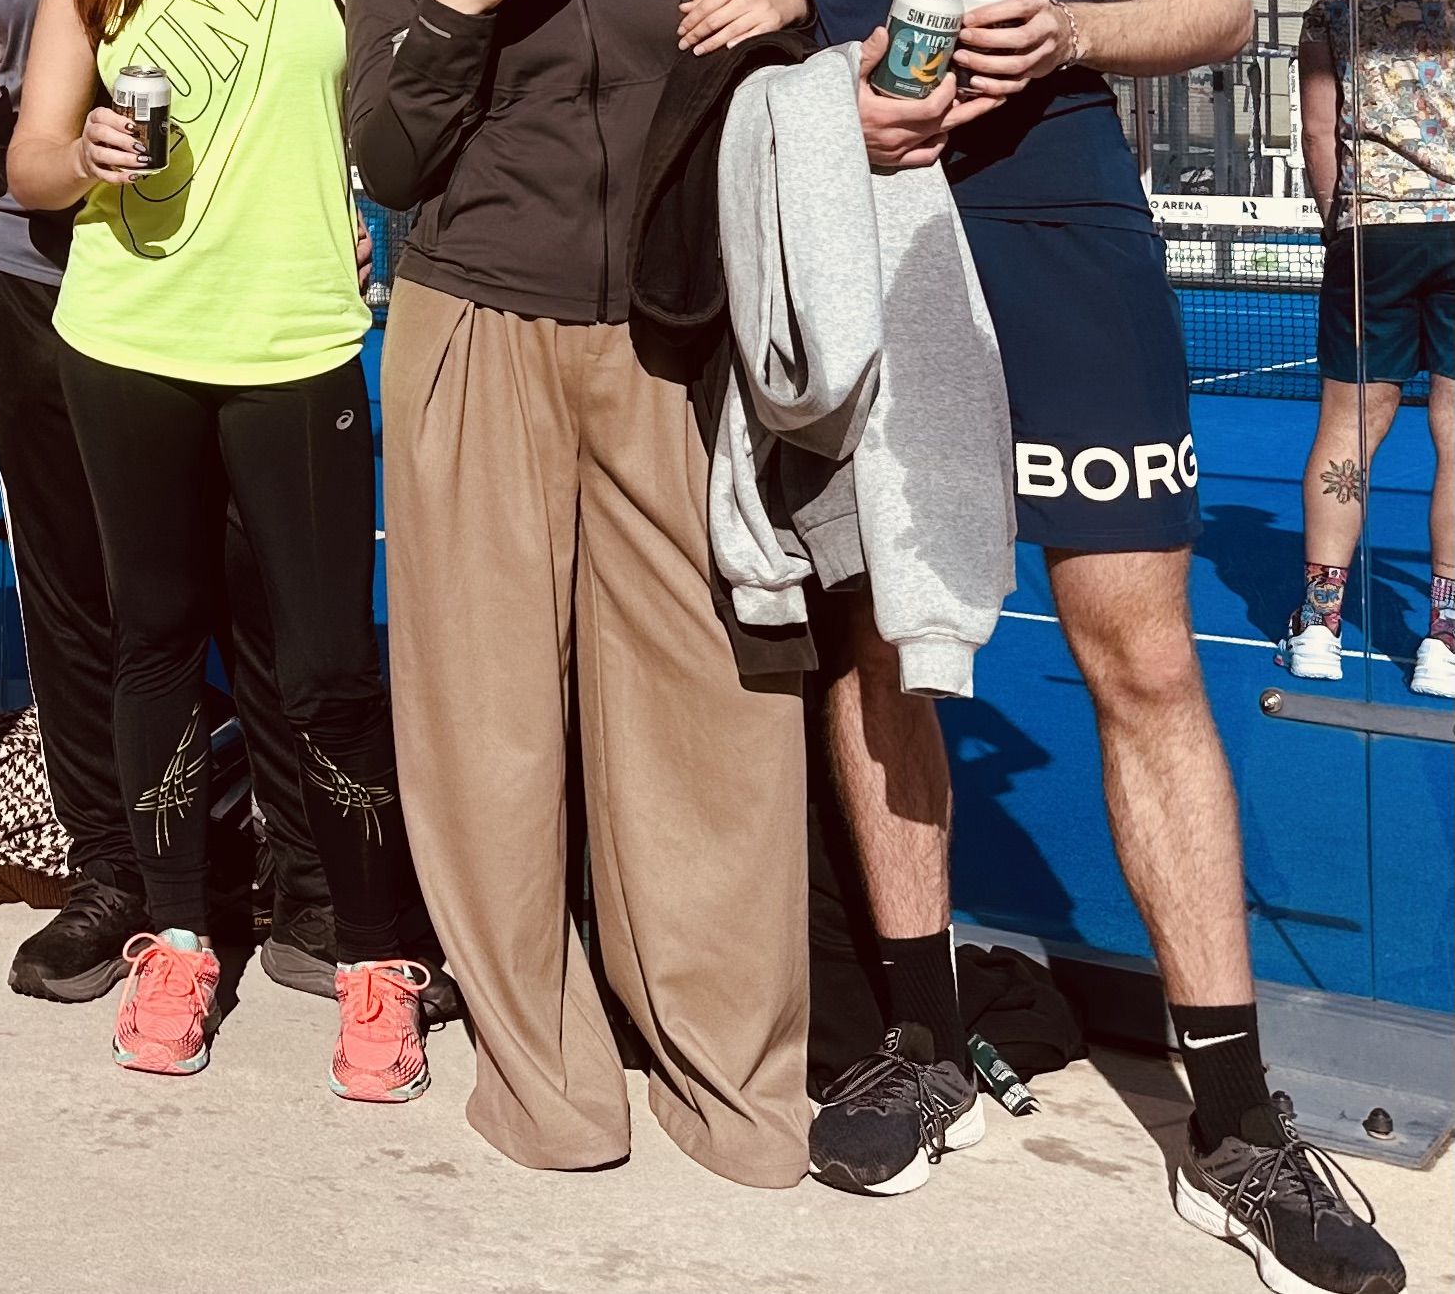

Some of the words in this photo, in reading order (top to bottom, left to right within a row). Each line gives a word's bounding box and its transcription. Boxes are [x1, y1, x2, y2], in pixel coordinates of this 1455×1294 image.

[907, 8, 924, 25] SIN
[913, 30, 952, 49] GUILA
[1162, 200, 1203, 211] ARENA
[1016, 433, 1199, 501] BORG
